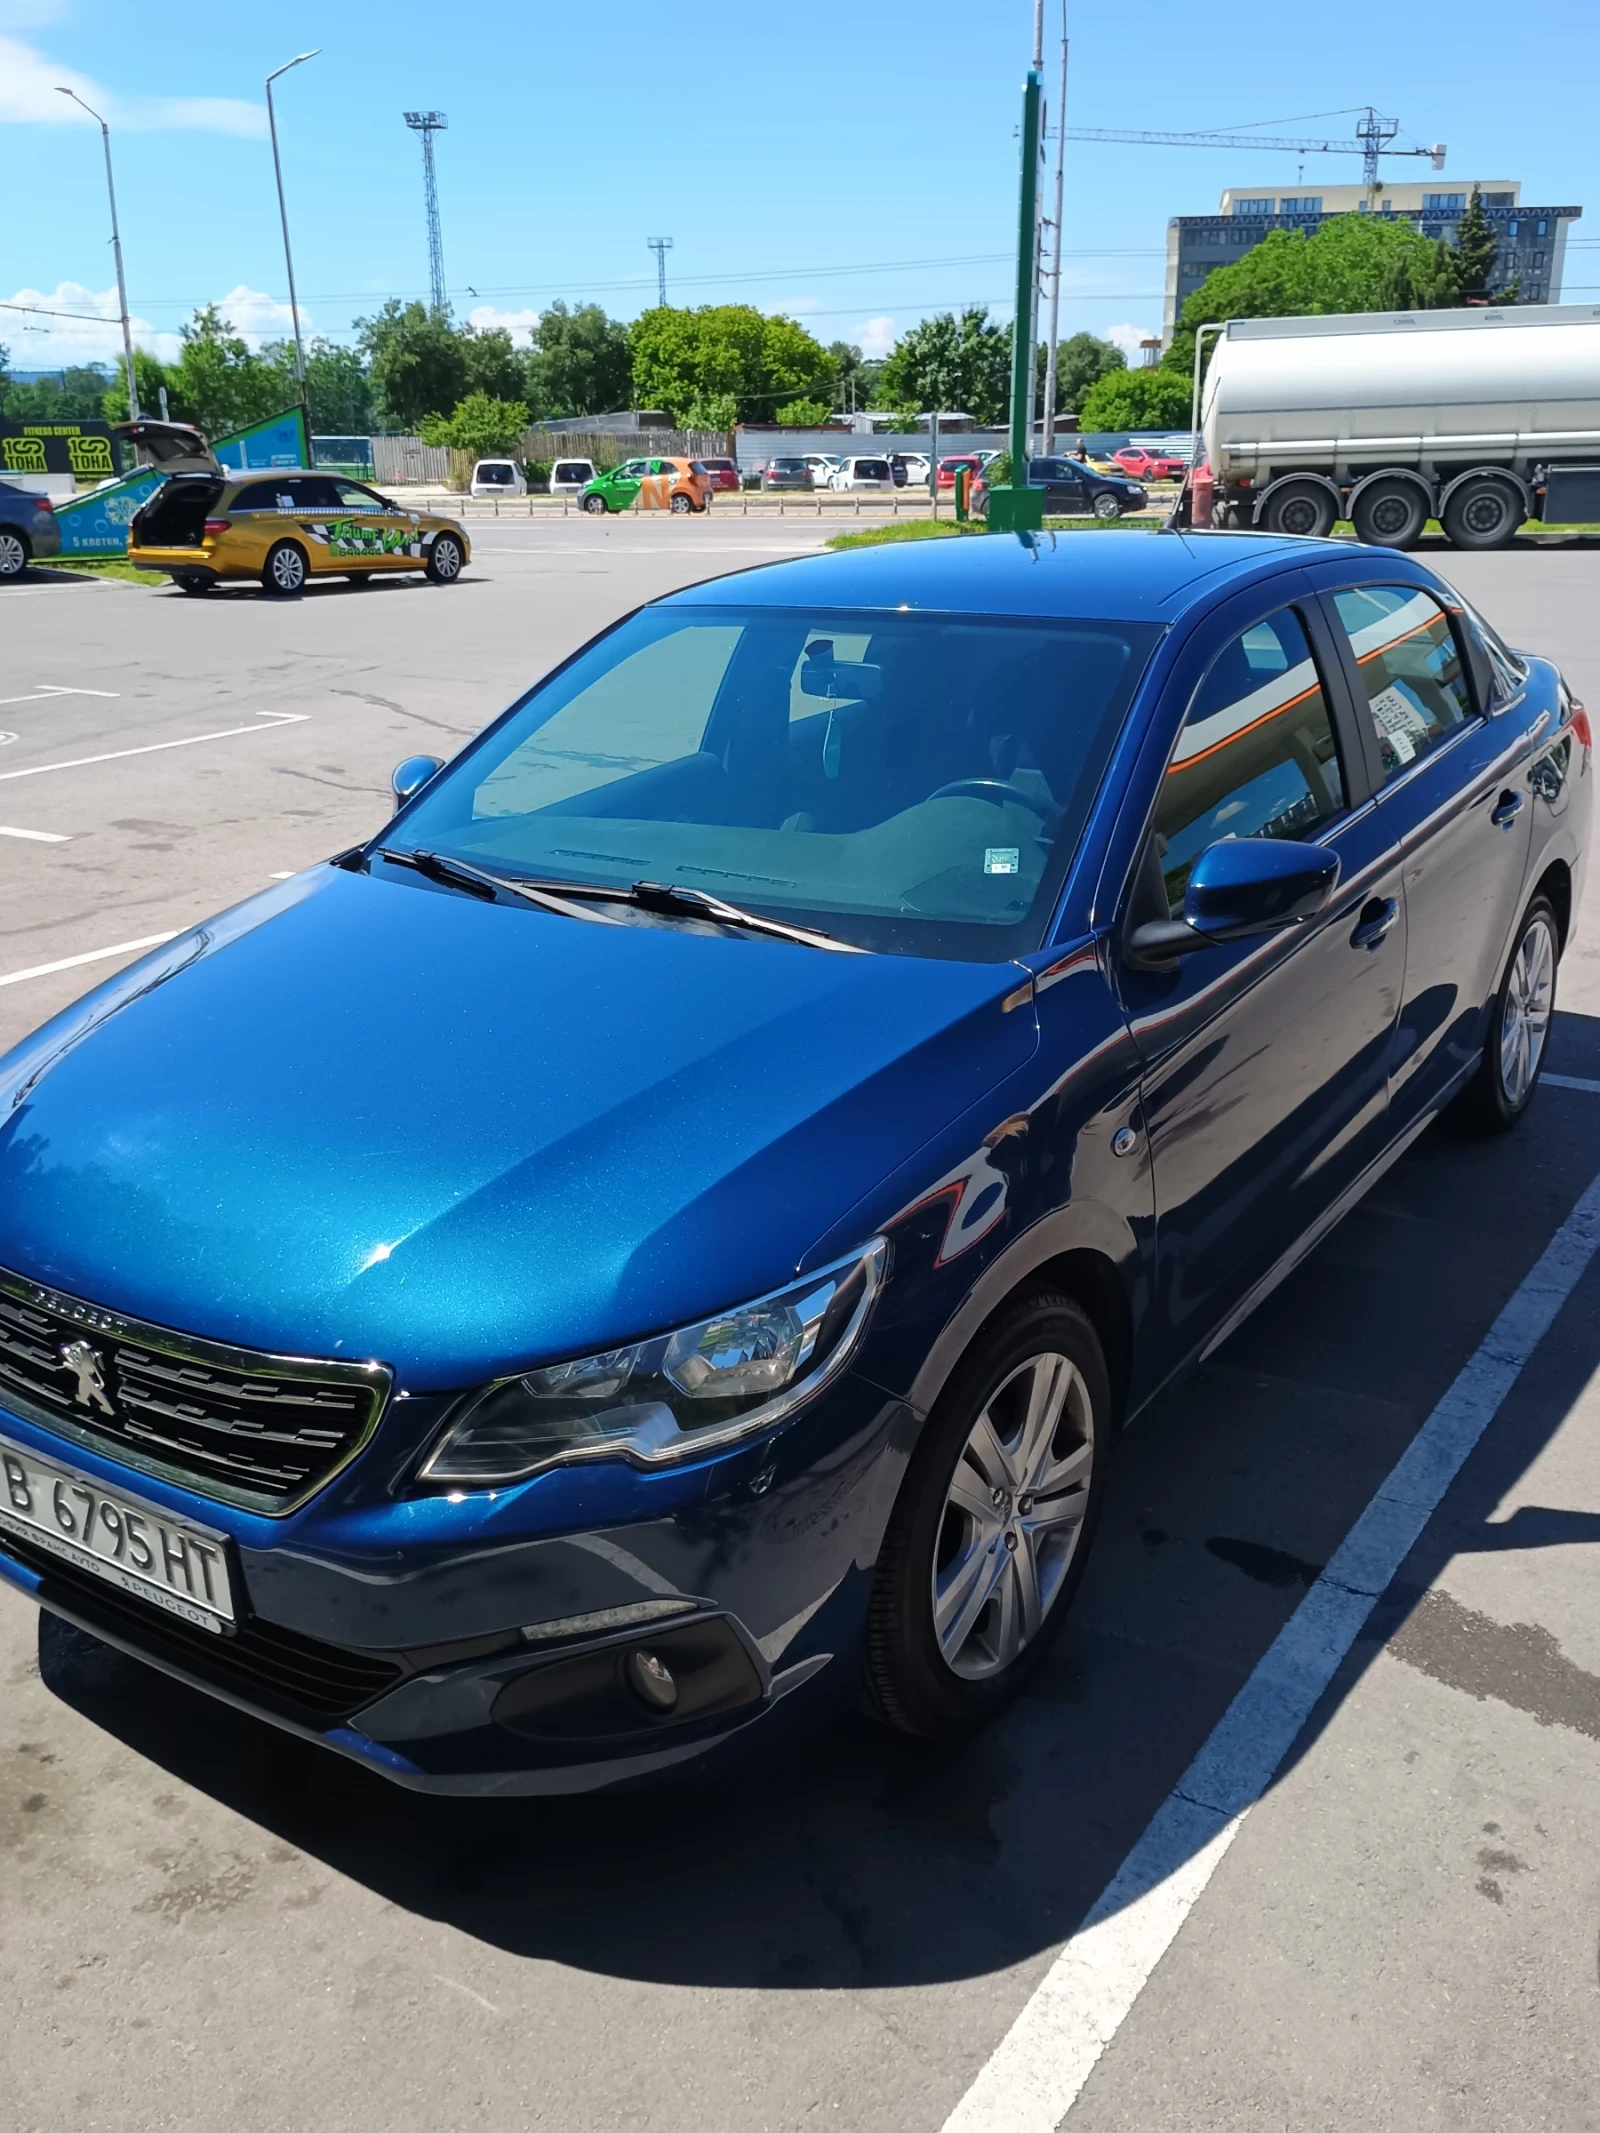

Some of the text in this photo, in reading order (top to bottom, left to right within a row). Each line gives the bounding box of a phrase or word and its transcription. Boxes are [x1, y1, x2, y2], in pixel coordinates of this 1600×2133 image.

[23, 426, 81, 436] FITNESS CENTER
[132, 1581, 211, 1627] PEUGEOT
